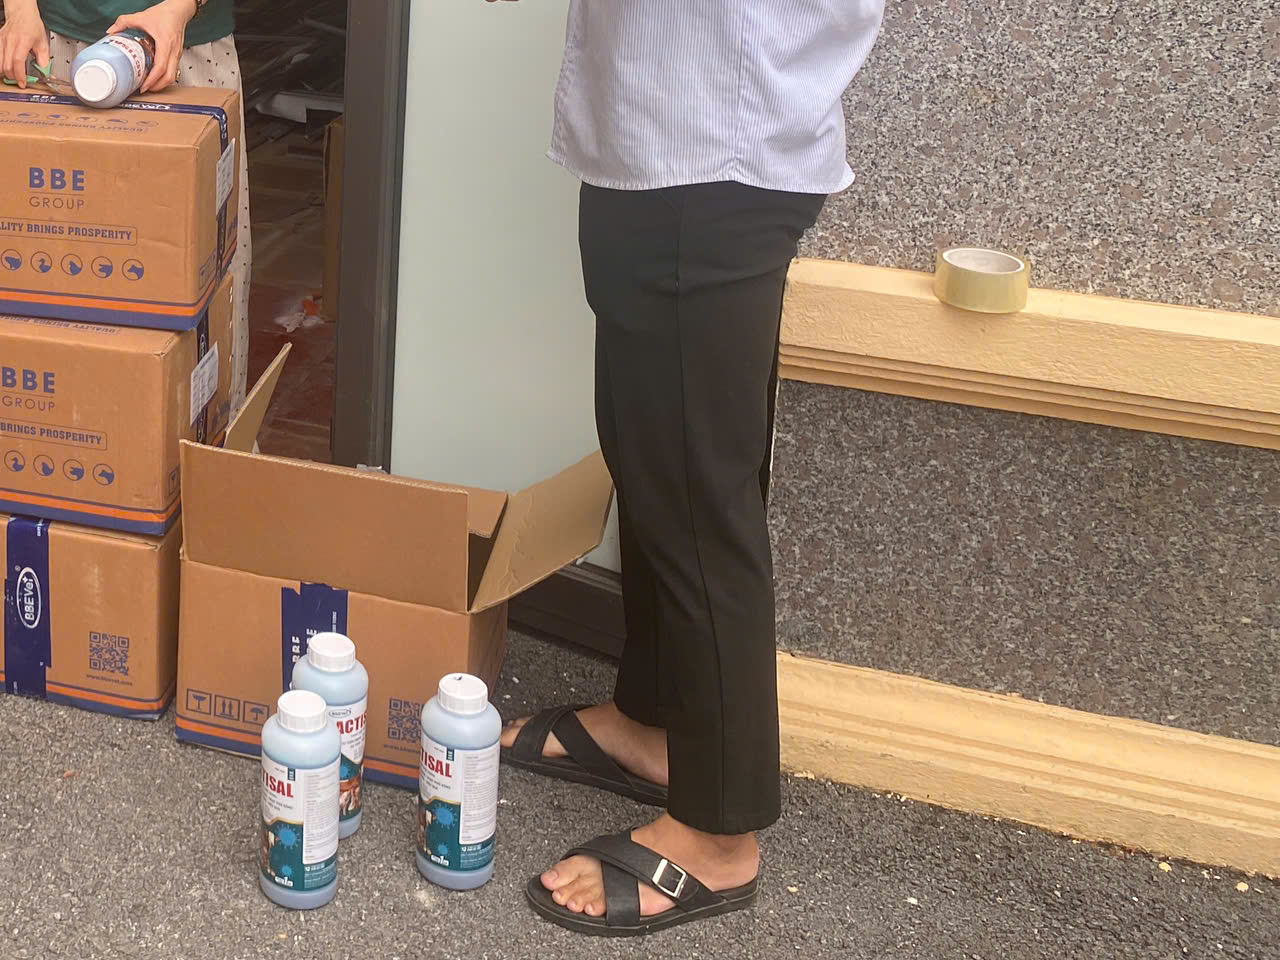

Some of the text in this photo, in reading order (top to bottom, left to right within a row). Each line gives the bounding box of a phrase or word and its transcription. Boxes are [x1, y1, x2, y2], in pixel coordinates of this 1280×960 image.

[29, 167, 84, 191] BBE
[29, 196, 85, 210] GROUP
[26, 223, 64, 235] BRINGS
[67, 227, 132, 240] PROSPERITY
[1, 366, 55, 394] BBE
[1, 395, 55, 412] GROUP
[0, 421, 37, 436] BRINGS
[39, 427, 102, 445] PROSPERITY
